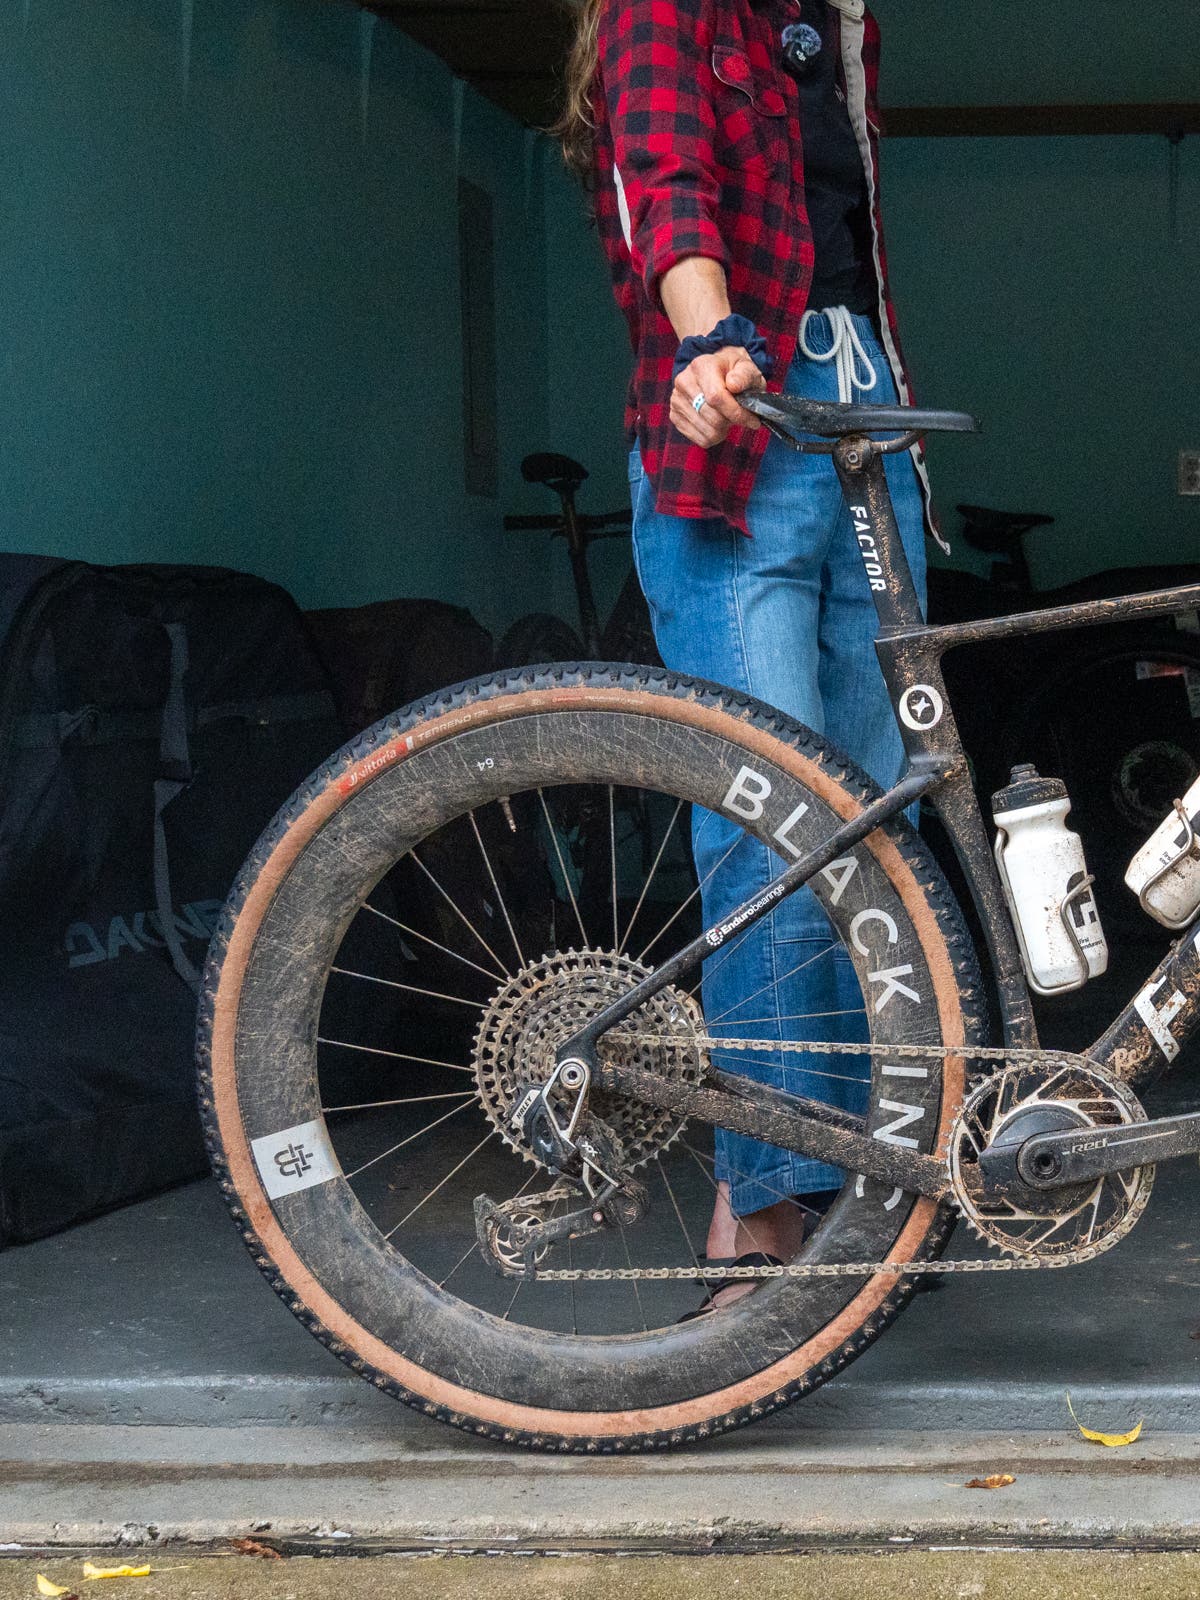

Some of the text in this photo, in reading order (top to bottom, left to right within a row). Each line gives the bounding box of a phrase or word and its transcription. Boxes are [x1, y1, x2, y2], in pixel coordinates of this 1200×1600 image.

[850, 505, 887, 592] FACTOR
[357, 749, 397, 780] vittoria
[476, 757, 494, 772] 64
[720, 884, 785, 933] Endurobearings
[722, 764, 922, 1014] BLACK
[516, 1095, 533, 1120] HALEY
